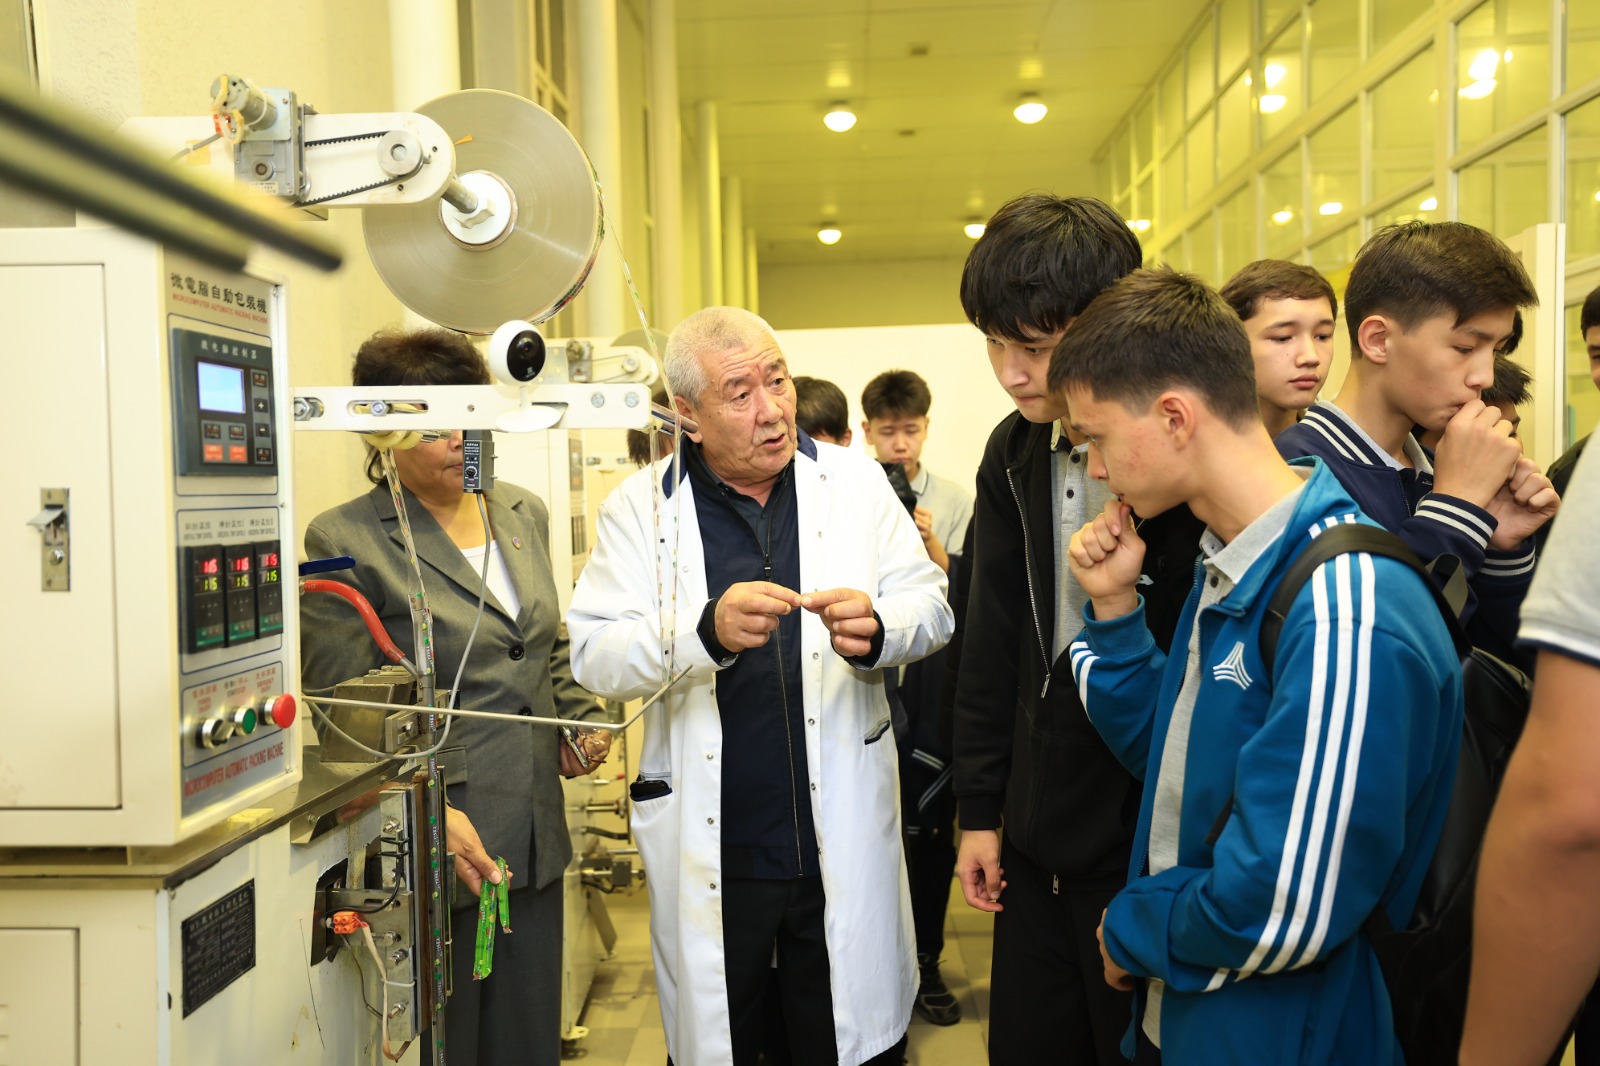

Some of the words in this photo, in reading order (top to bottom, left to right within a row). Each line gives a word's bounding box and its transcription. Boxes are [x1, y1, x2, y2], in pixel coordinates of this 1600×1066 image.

[171, 273, 267, 314] 微電腦自動包裝機
[184, 767, 225, 798] MICROCOMPUTER
[225, 758, 249, 780] AUTOMATIC
[249, 748, 267, 768] PACKING
[267, 741, 284, 759] MACHINE
